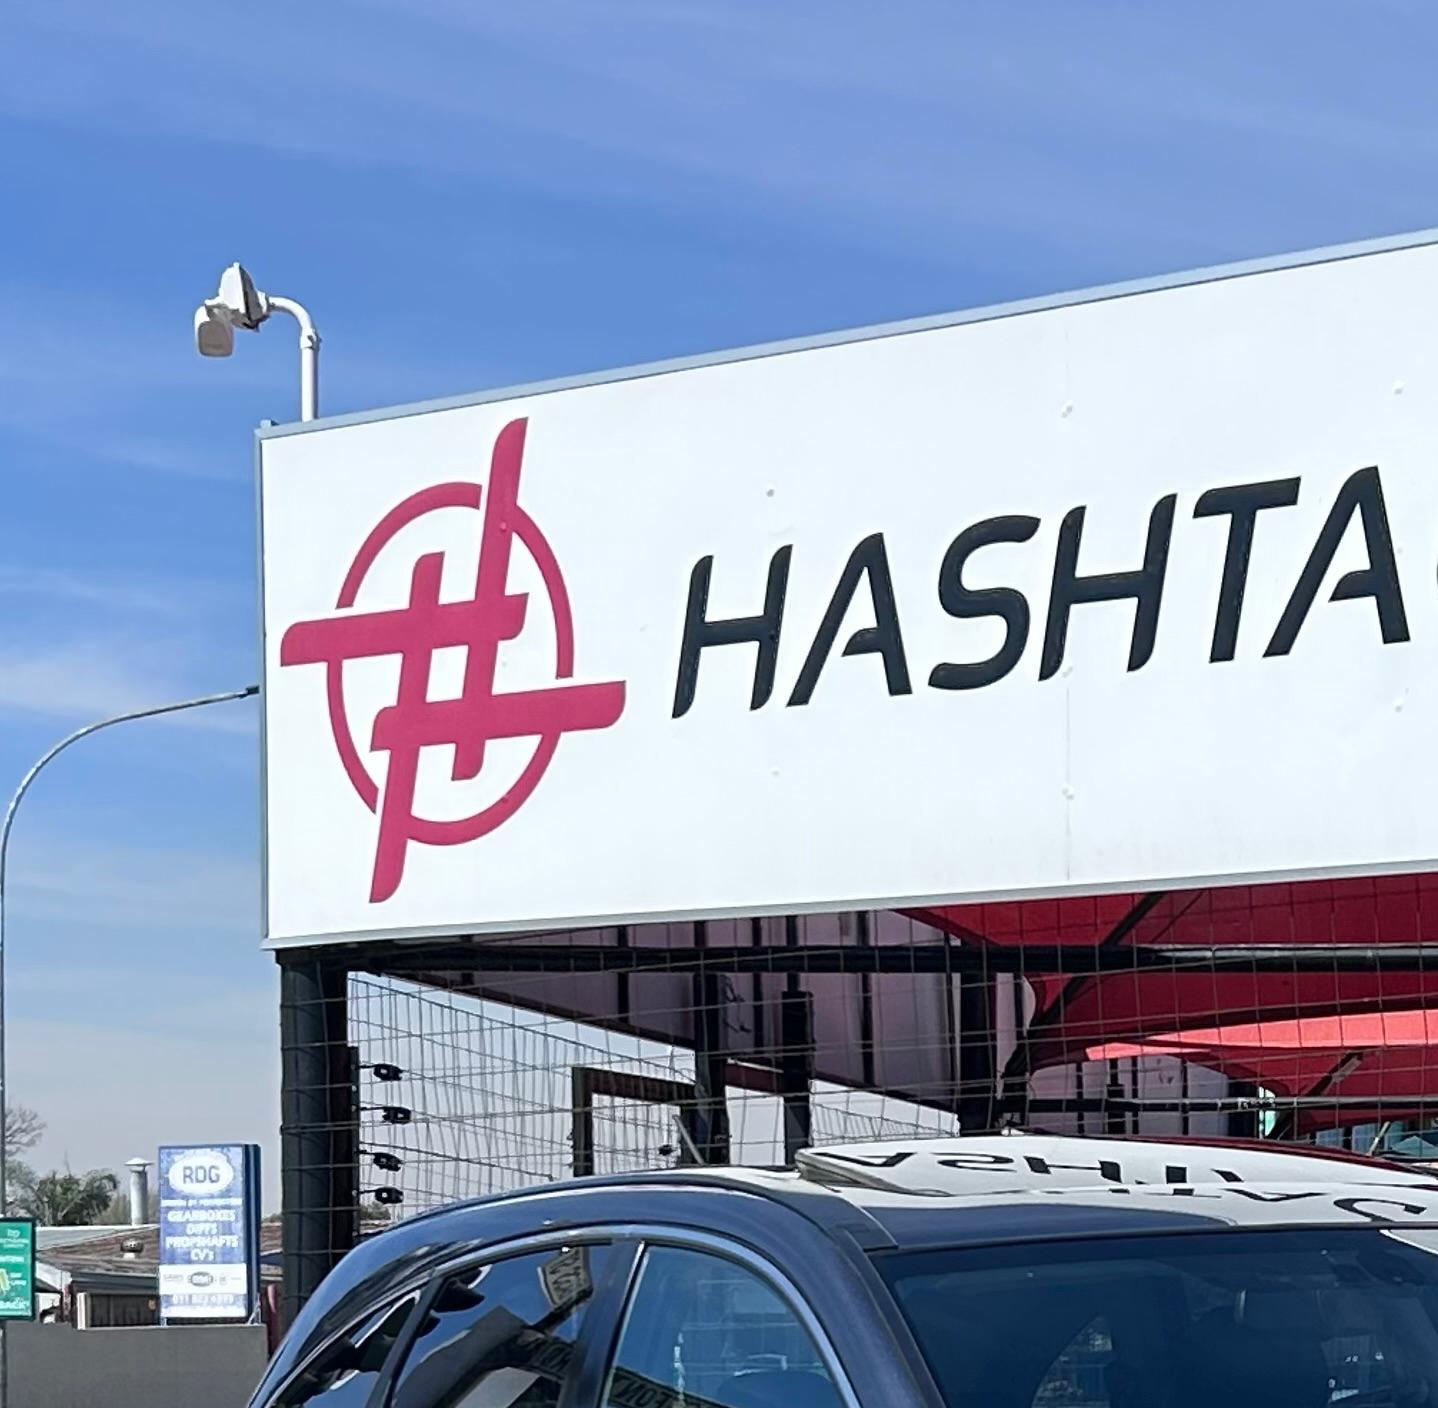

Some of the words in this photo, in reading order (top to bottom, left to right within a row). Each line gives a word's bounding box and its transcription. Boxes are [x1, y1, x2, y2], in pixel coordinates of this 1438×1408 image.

[182, 1165, 220, 1184] RDG
[167, 1209, 236, 1222] GEARBOXES
[165, 1235, 239, 1248] PROPSHAFTS
